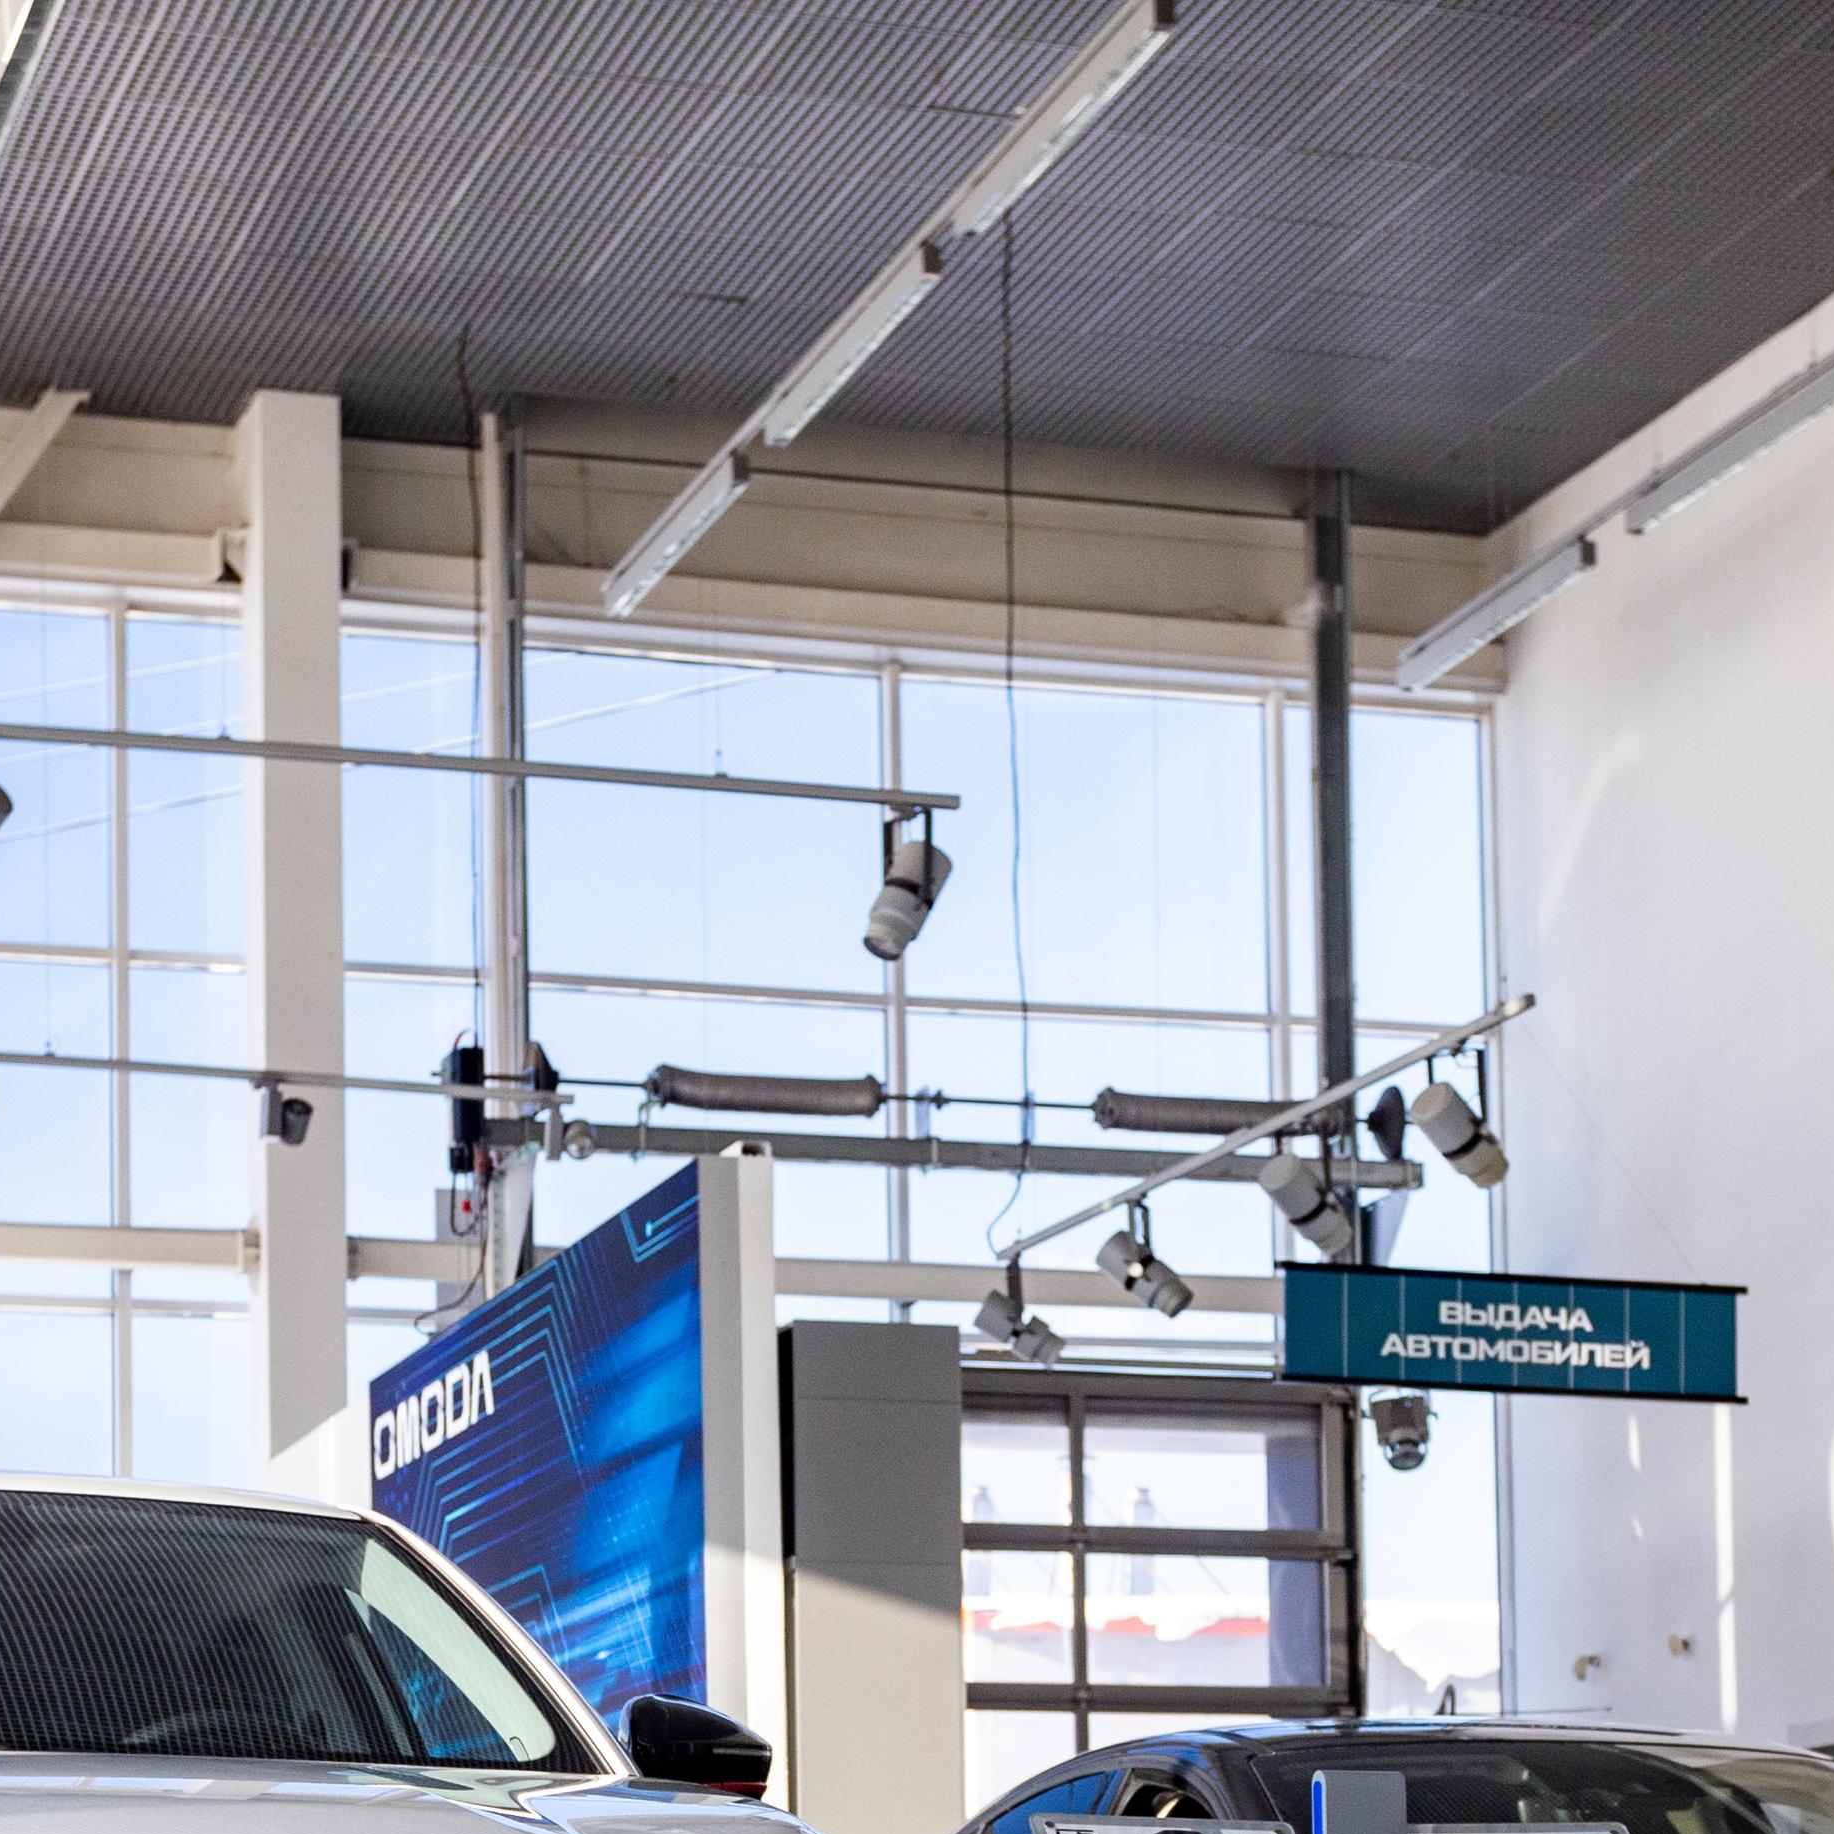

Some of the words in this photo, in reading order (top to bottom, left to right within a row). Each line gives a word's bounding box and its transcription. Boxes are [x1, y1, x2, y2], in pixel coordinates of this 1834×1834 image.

[1439, 1300, 1593, 1332] ВЫДАЧА
[1380, 1333, 1651, 1371] АВТОМОБИЛЕЙ
[373, 1350, 495, 1481] OMODA
